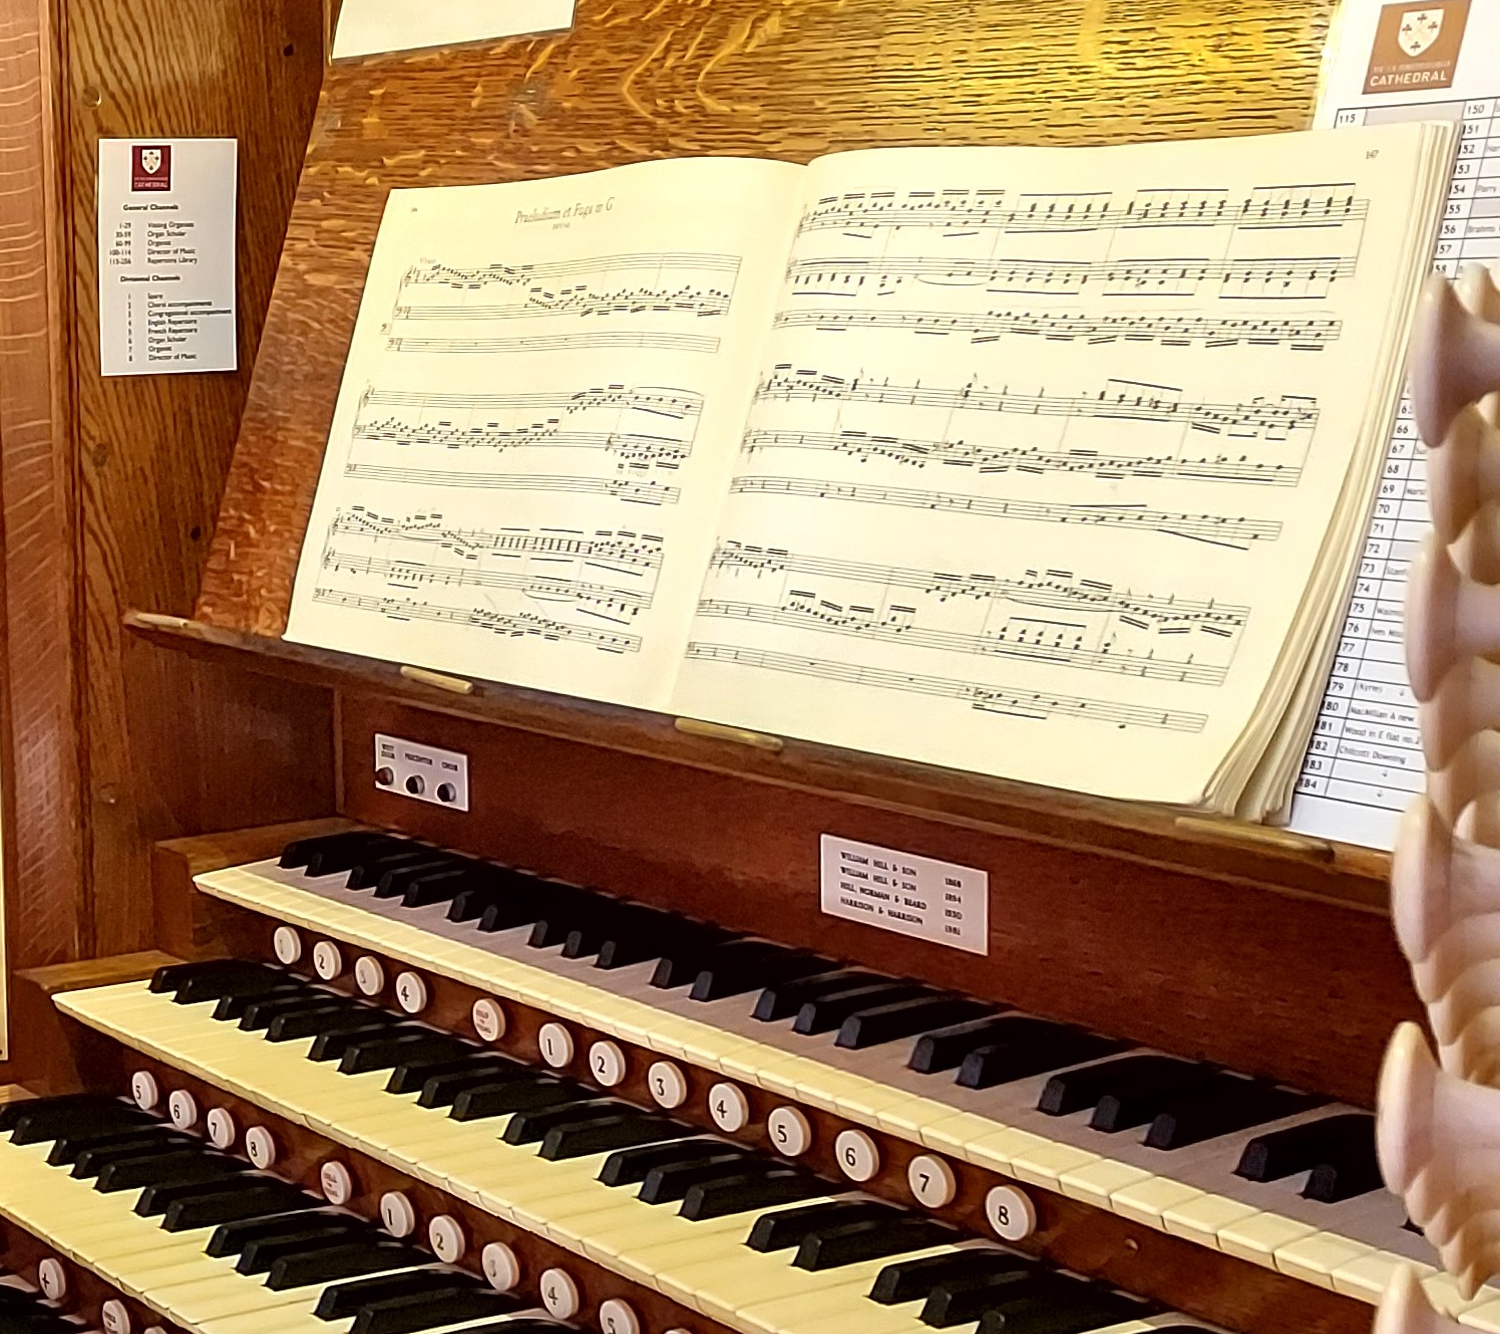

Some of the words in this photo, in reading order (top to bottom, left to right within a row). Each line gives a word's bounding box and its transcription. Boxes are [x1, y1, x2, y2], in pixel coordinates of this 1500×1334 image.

[1369, 70, 1448, 86] CATHEDRAL
[1339, 113, 1356, 124] 115
[1467, 104, 1485, 114] 150
[1398, 713, 1415, 723] new
[1345, 726, 1367, 737] Wood
[1369, 729, 1376, 738] in
[1378, 730, 1384, 740] E
[1385, 731, 1400, 742] flat
[840, 851, 869, 866] WILLIAM
[873, 859, 889, 870] HILL
[892, 864, 898, 872] &
[902, 866, 917, 877] SON
[840, 866, 869, 881] WILLIAM
[873, 874, 889, 885] HILL
[892, 879, 898, 887] &
[902, 882, 917, 892] SON
[859, 886, 890, 901] NORMAN
[895, 895, 900, 903] &
[903, 898, 927, 910] BEARD
[840, 896, 874, 912] HARRISON
[878, 906, 884, 915] &
[887, 909, 923, 926] HARRISON
[318, 954, 325, 970] 2
[400, 985, 410, 1002] 4
[597, 1055, 606, 1074] 2
[135, 1084, 142, 1100] 5
[656, 1077, 665, 1097] 3
[173, 1104, 181, 1120] 6
[716, 1099, 728, 1119] 4
[211, 1121, 217, 1137] 7
[777, 1124, 788, 1144] 5
[250, 1141, 258, 1158] 8
[845, 1147, 856, 1167] 6
[919, 1173, 930, 1193] 7
[387, 1208, 393, 1227] 1
[997, 1205, 1010, 1226] 8
[435, 1232, 444, 1251] 2
[547, 1286, 559, 1306] 4
